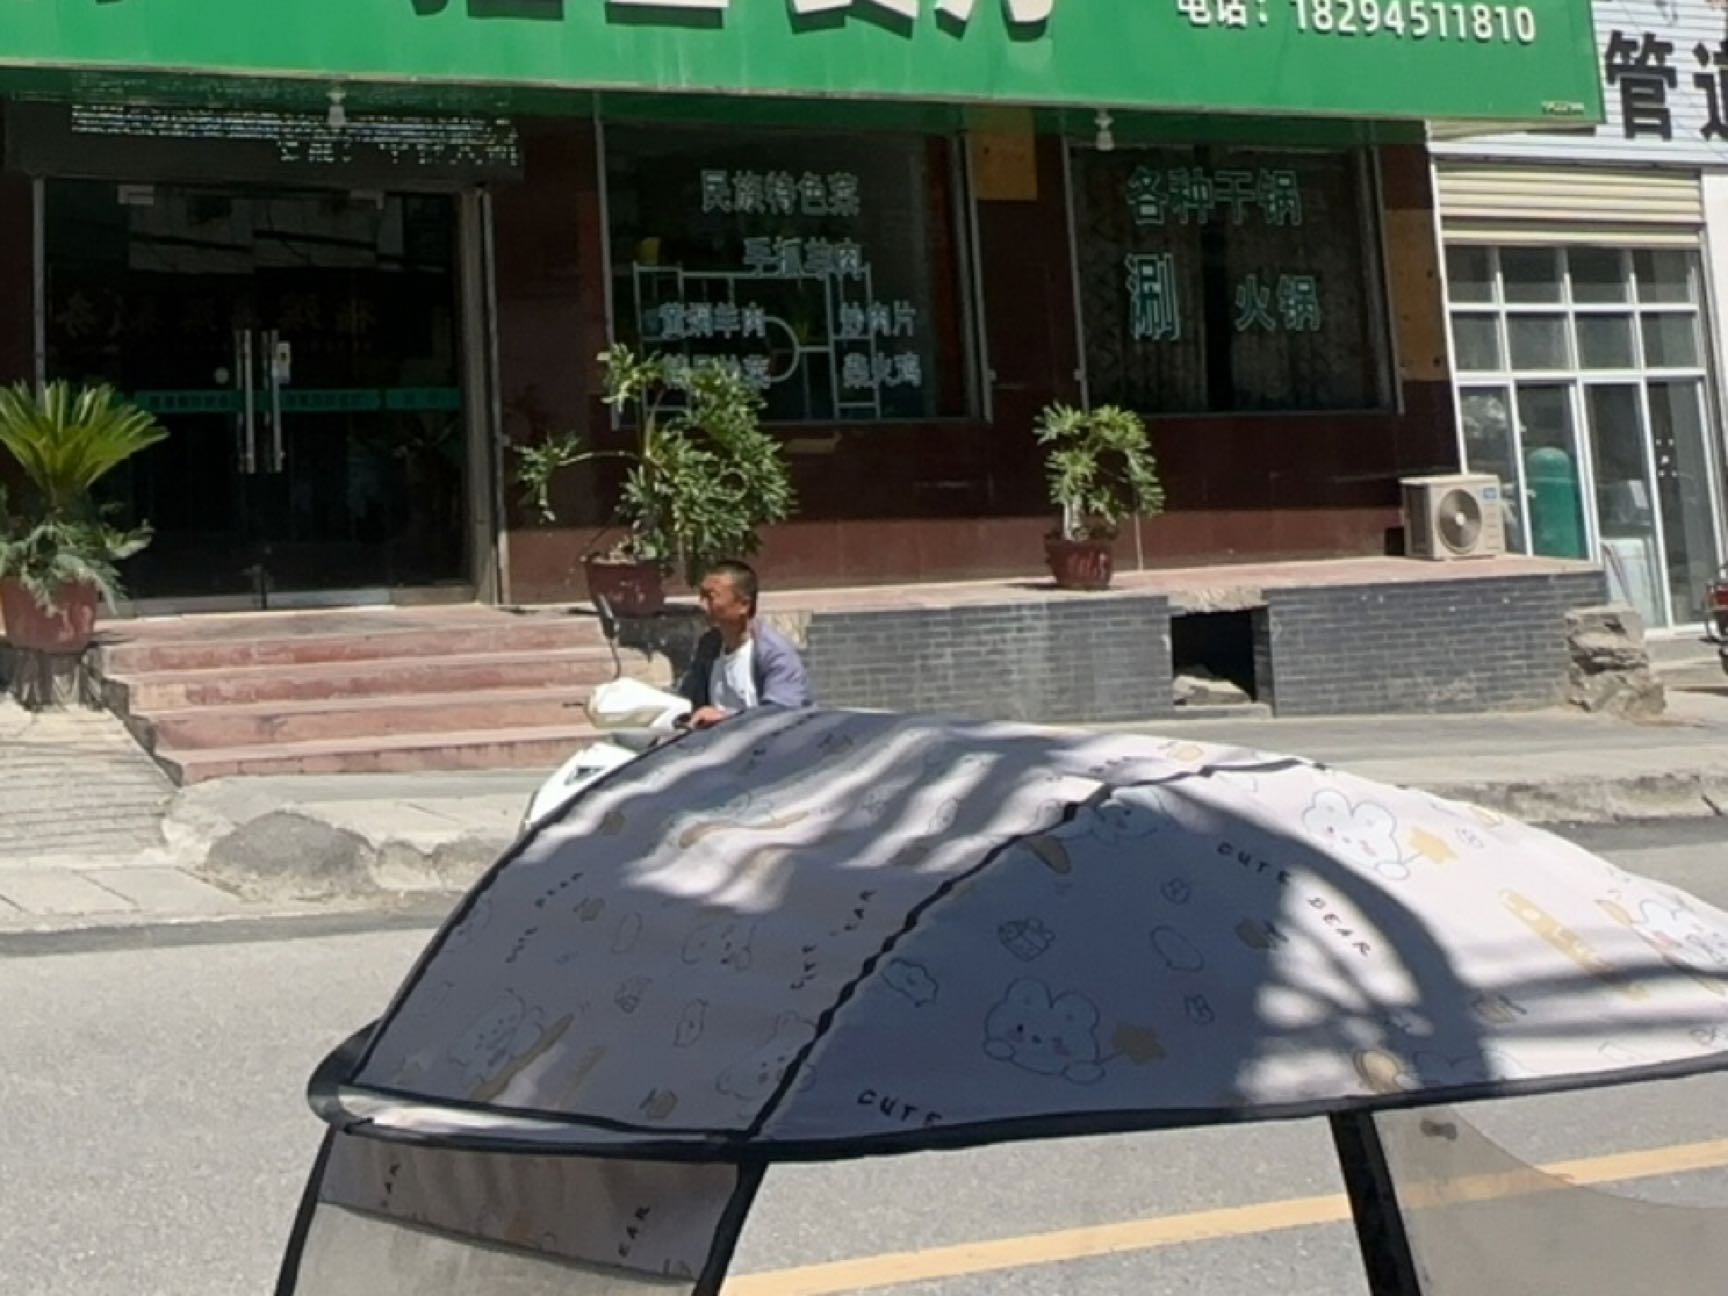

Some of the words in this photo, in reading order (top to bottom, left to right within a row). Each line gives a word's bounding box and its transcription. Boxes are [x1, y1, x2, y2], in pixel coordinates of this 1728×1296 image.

[1125, 165, 1304, 226] 各种干锅
[1234, 272, 1322, 332] 火锅
